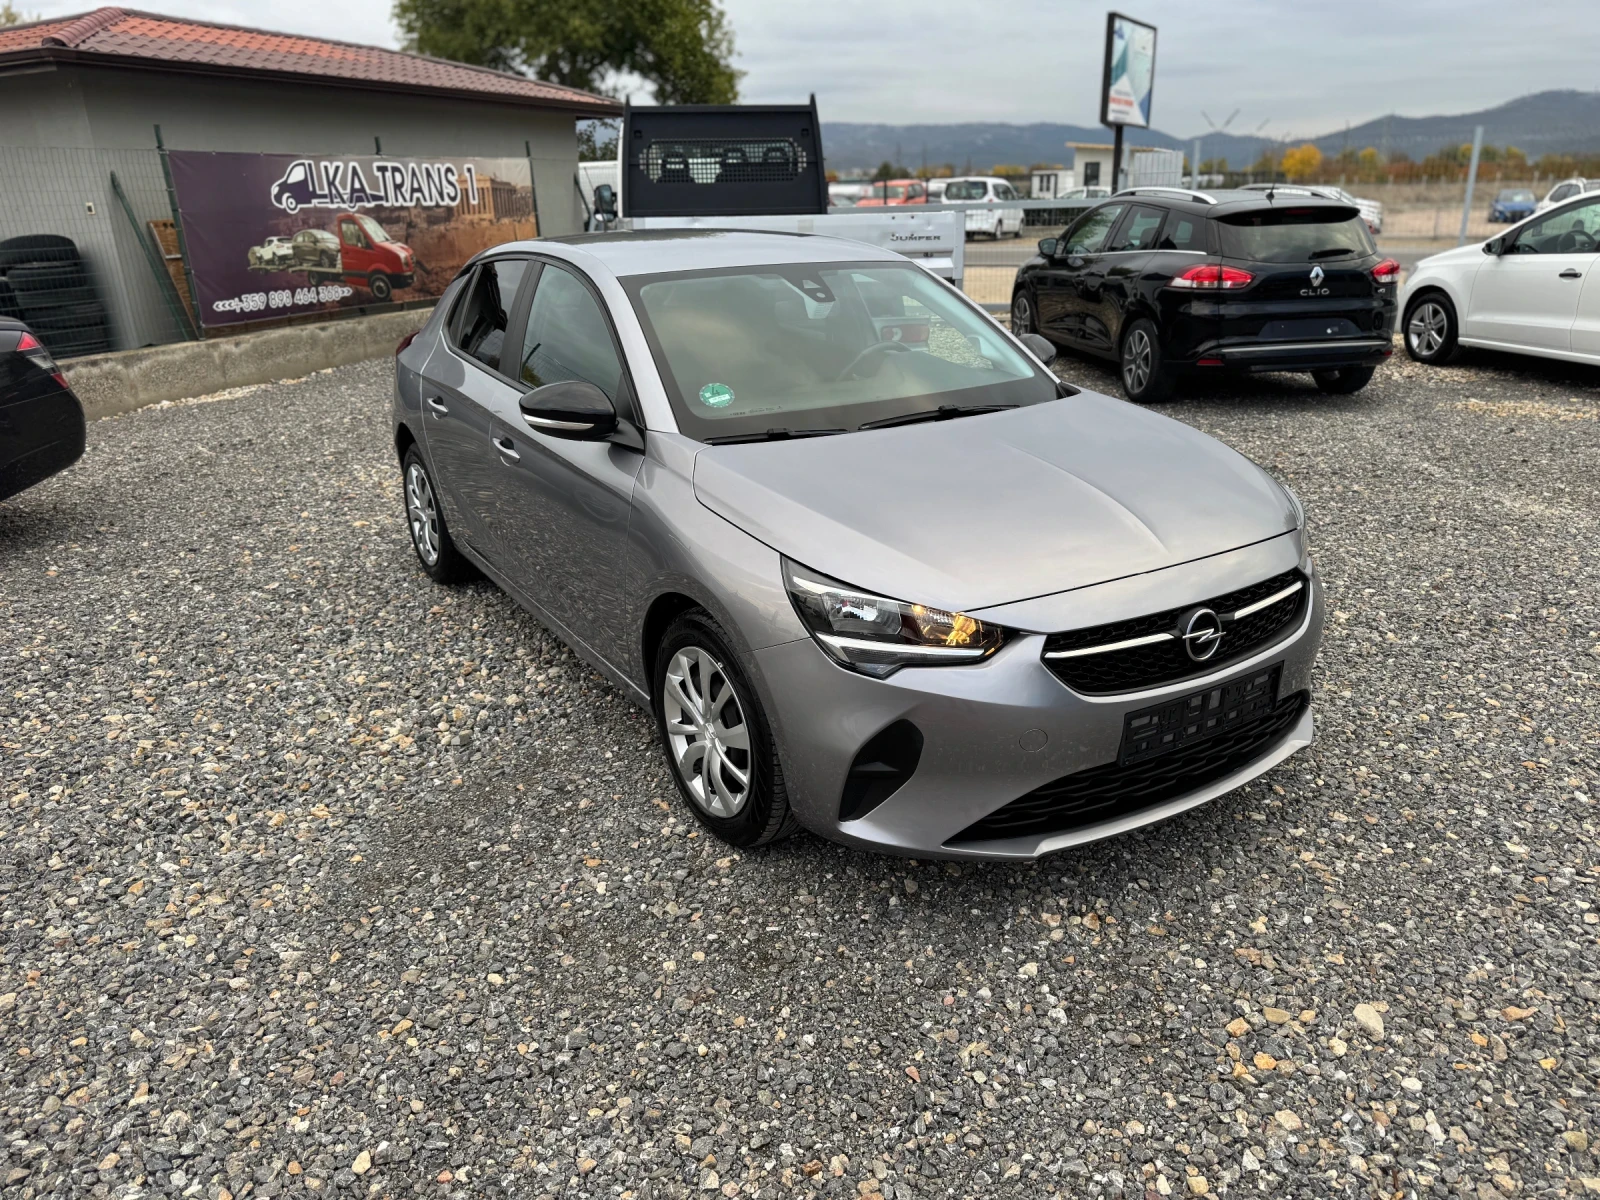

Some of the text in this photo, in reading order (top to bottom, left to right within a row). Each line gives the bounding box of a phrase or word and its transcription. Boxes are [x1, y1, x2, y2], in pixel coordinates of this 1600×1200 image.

[373, 162, 461, 207] TRANS
[268, 290, 292, 308] 898
[294, 287, 318, 305] 464
[1300, 288, 1330, 296] CLIO
